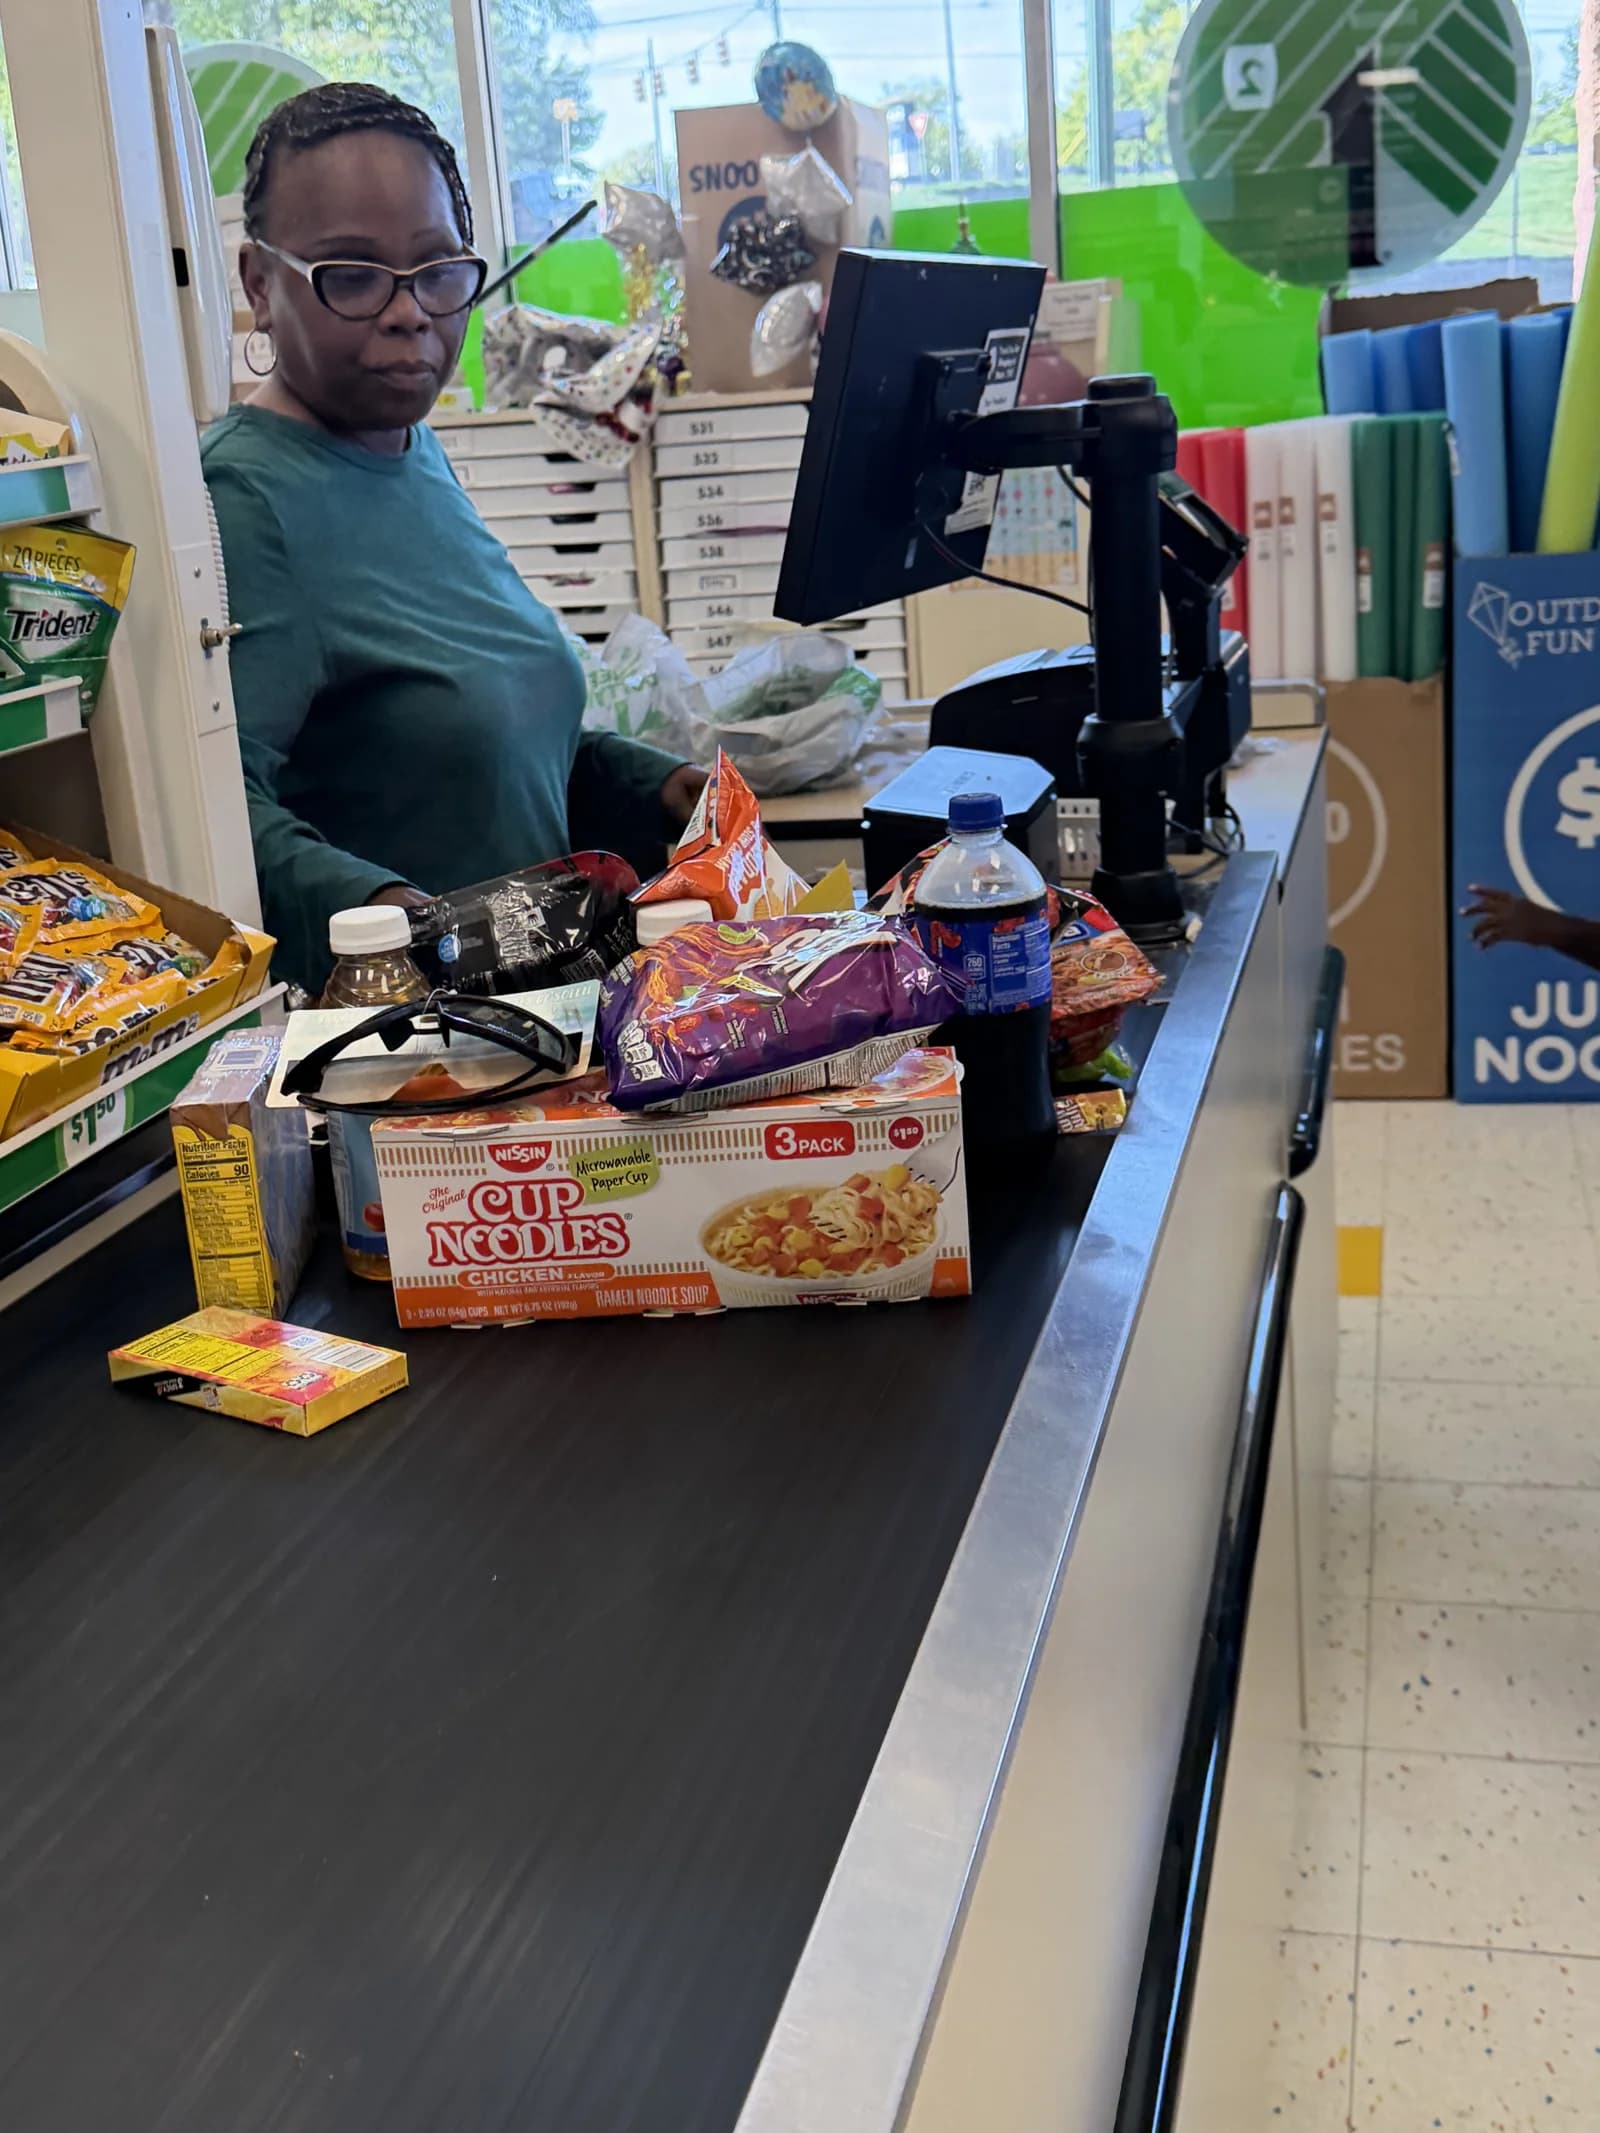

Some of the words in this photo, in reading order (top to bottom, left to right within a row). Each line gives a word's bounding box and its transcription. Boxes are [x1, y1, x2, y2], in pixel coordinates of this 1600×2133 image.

[34, 551, 82, 573] PIECES
[5, 607, 100, 641] Trident
[1526, 628, 1594, 656] FUN
[182, 1140, 220, 1153] Nutrition
[222, 1138, 247, 1150] Facts
[774, 1126, 797, 1156] 3
[799, 1137, 845, 1153] PACK
[495, 1145, 545, 1163] NISSIN
[576, 1148, 652, 1177] Microwavable
[185, 1168, 220, 1179] Calories
[233, 1164, 249, 1176] 90
[591, 1175, 625, 1192] Paper
[626, 1170, 649, 1185] Cup
[422, 1190, 467, 1214] Original
[428, 1186, 450, 1200] The
[470, 1181, 582, 1222] CUP
[428, 1215, 628, 1265] NOODLES
[466, 1268, 564, 1286] CHICKEN
[595, 1289, 633, 1308] RAMEN
[636, 1286, 679, 1306] NOODLE
[680, 1282, 710, 1303] SOUP
[468, 1305, 488, 1317] CUPS
